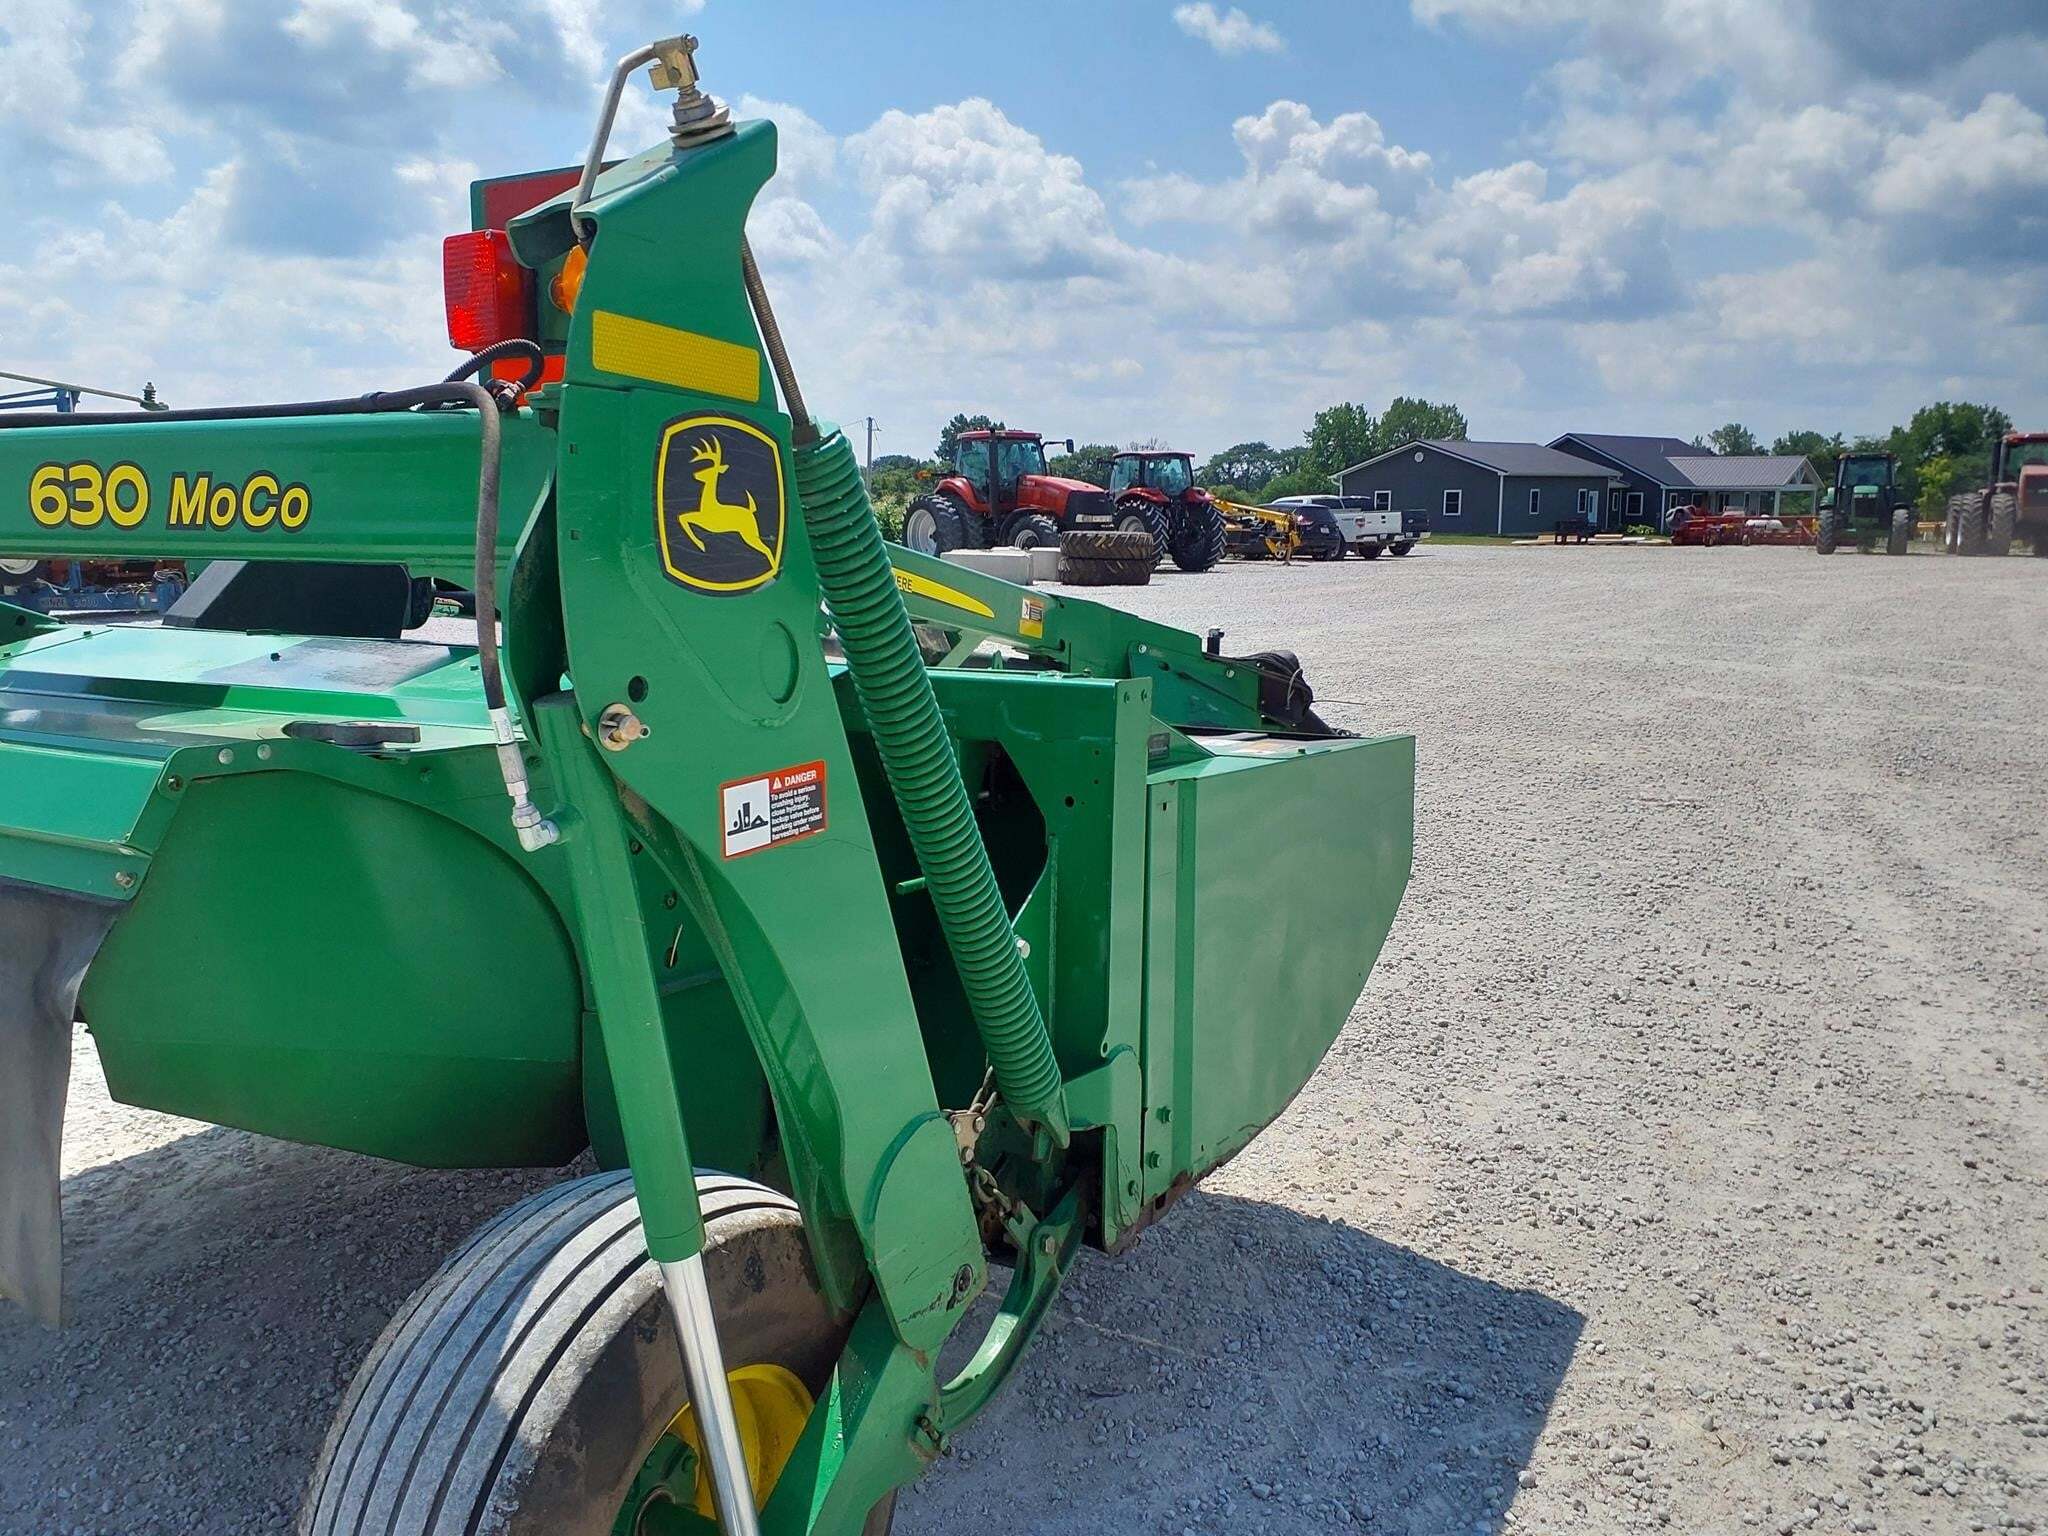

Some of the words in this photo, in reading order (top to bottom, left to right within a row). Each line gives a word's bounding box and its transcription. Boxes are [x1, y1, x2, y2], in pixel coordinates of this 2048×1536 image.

[29, 461, 150, 529] 630
[167, 471, 311, 531] MoCo
[897, 576, 912, 590] ERE
[785, 770, 816, 786] DANGER
[779, 788, 793, 799] avoid
